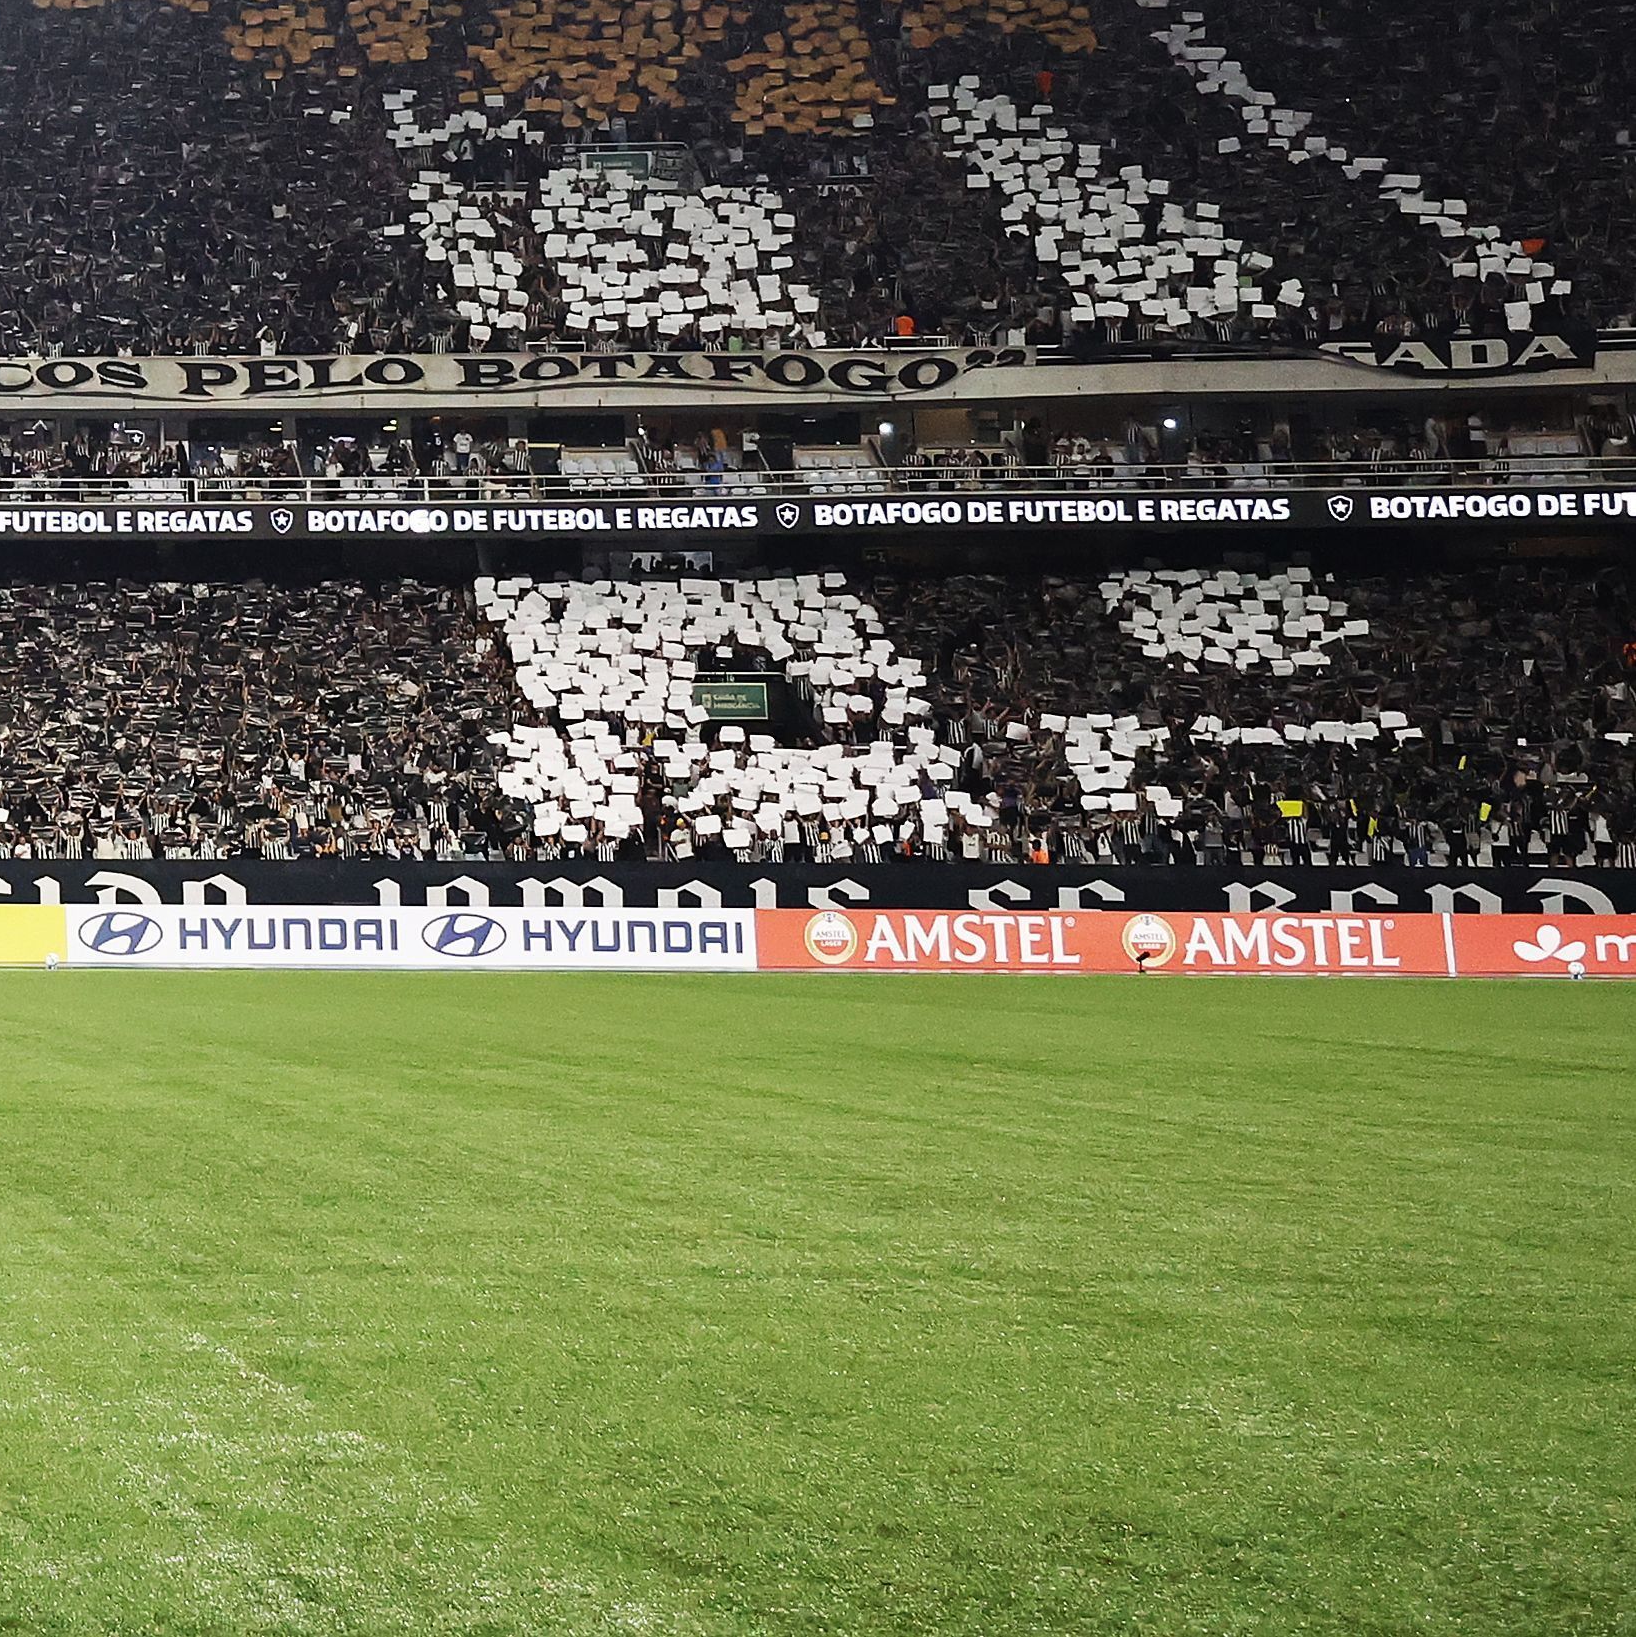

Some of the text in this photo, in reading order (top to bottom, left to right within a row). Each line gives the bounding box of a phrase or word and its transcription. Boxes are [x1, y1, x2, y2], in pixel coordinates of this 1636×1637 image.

[178, 360, 425, 397] PELO
[457, 356, 958, 394] BOTAFOGO
[307, 507, 758, 533] BOTAFOGO DE FUTEBOL E REGATAS
[814, 498, 1290, 526] BOTAFOGO DE FUTEBOL E REGATAS
[1370, 495, 1531, 519] BOTAFOGO
[1537, 494, 1578, 516] DE
[116, 511, 133, 532] E
[137, 511, 253, 532] REGATAS
[179, 917, 399, 951] HYUNDAI
[522, 919, 743, 954] HYUNDAI
[815, 930, 846, 939] AMSTEL
[865, 912, 1080, 964] AMSTEL
[1133, 932, 1165, 941] AMSTEL
[1183, 915, 1401, 967] AMSTEL
